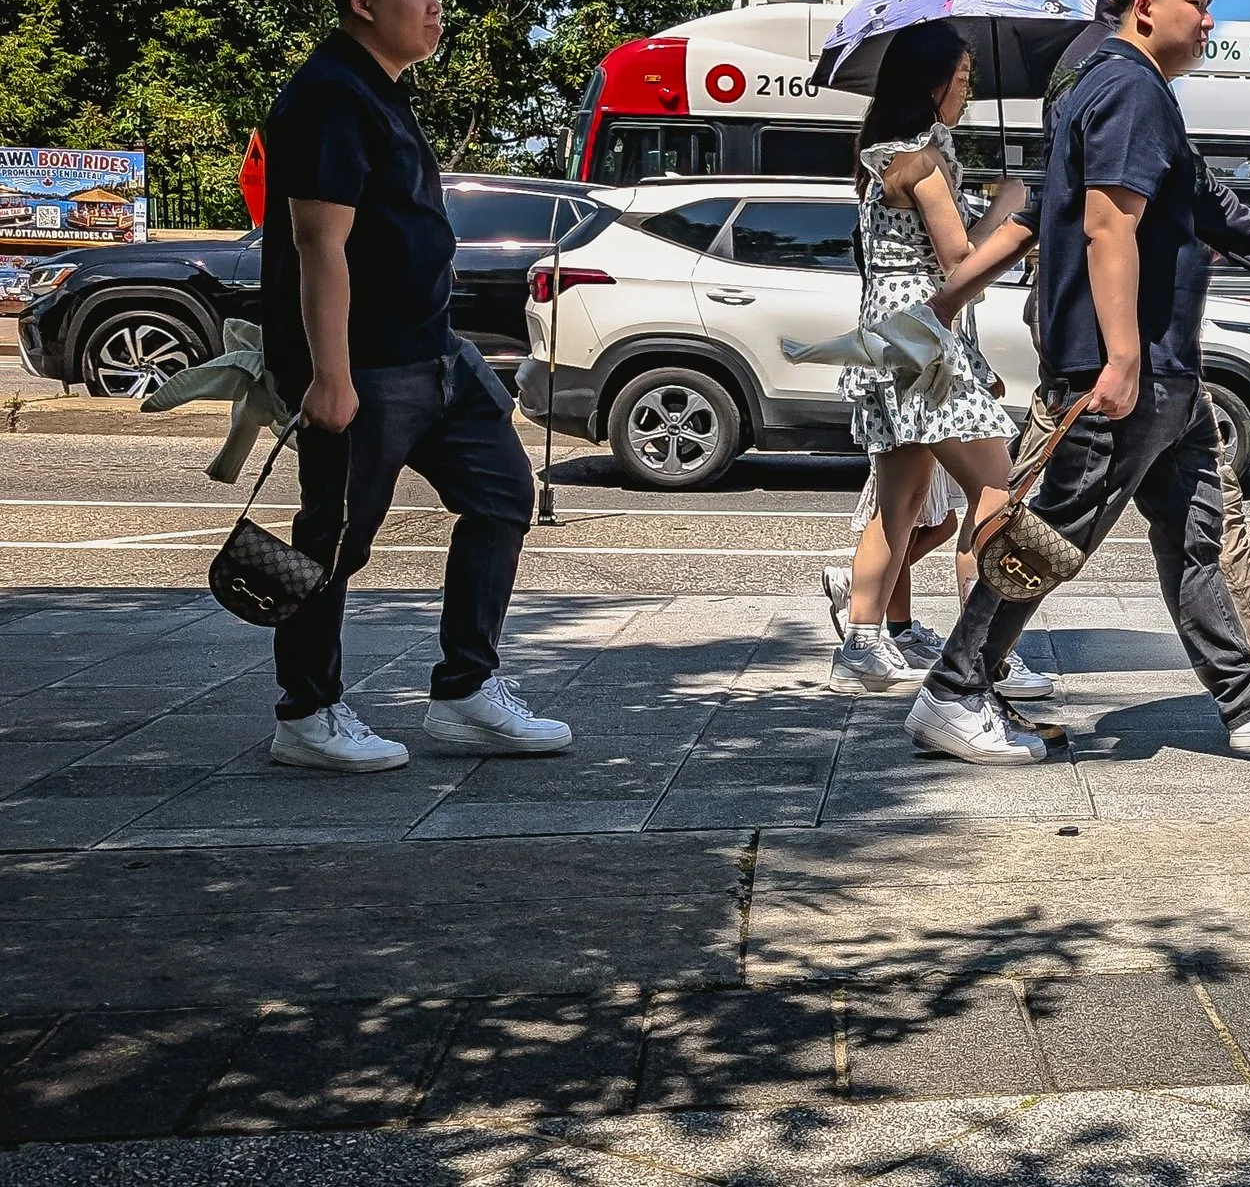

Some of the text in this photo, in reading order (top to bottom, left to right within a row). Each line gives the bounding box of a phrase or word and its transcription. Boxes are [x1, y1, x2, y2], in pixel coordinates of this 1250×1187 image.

[38, 151, 80, 167] BOAT
[83, 154, 130, 173] RIDES
[2, 169, 102, 180] PROMENADES EN BATEAU
